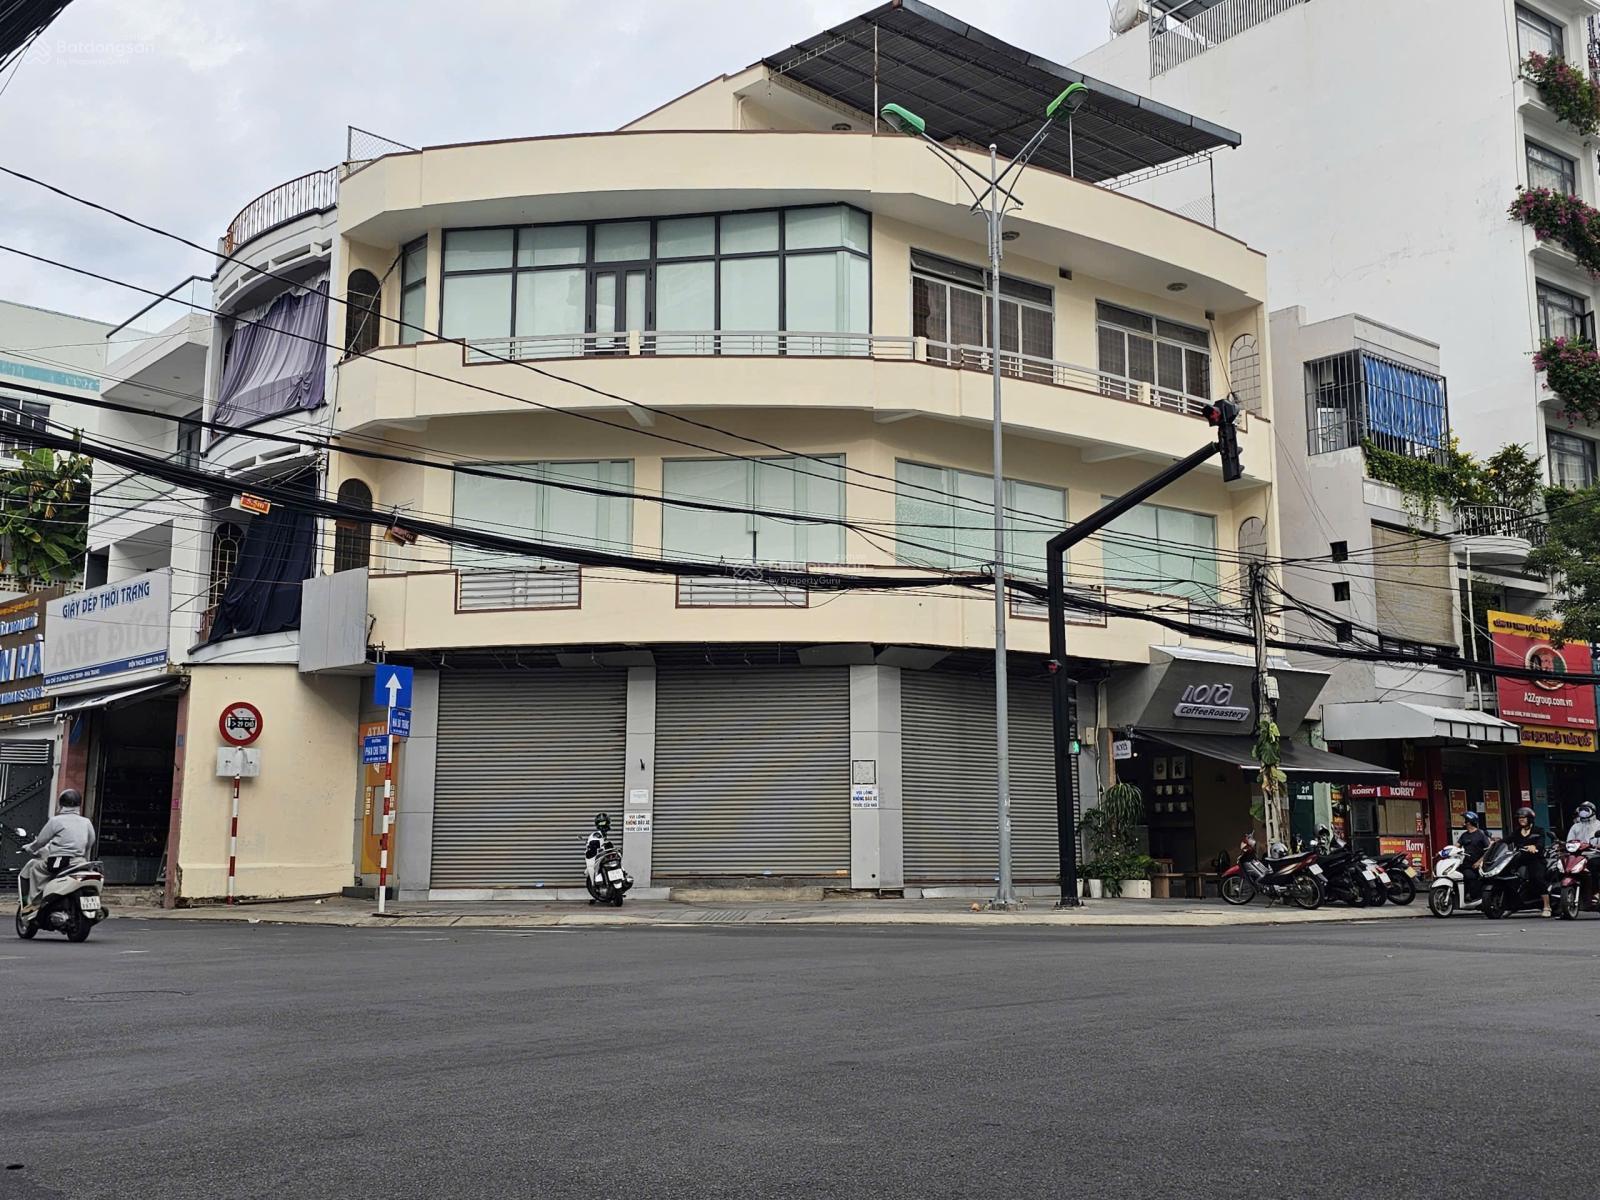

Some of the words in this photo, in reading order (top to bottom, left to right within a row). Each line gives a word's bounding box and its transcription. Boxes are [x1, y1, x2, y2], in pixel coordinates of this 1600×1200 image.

[121, 581, 150, 602] TRANG
[1523, 692, 1573, 707] A2Zgroup.com.vn
[367, 725, 385, 737] ATM
[1390, 787, 1416, 797] KORRY
[1405, 840, 1424, 852] Korry
